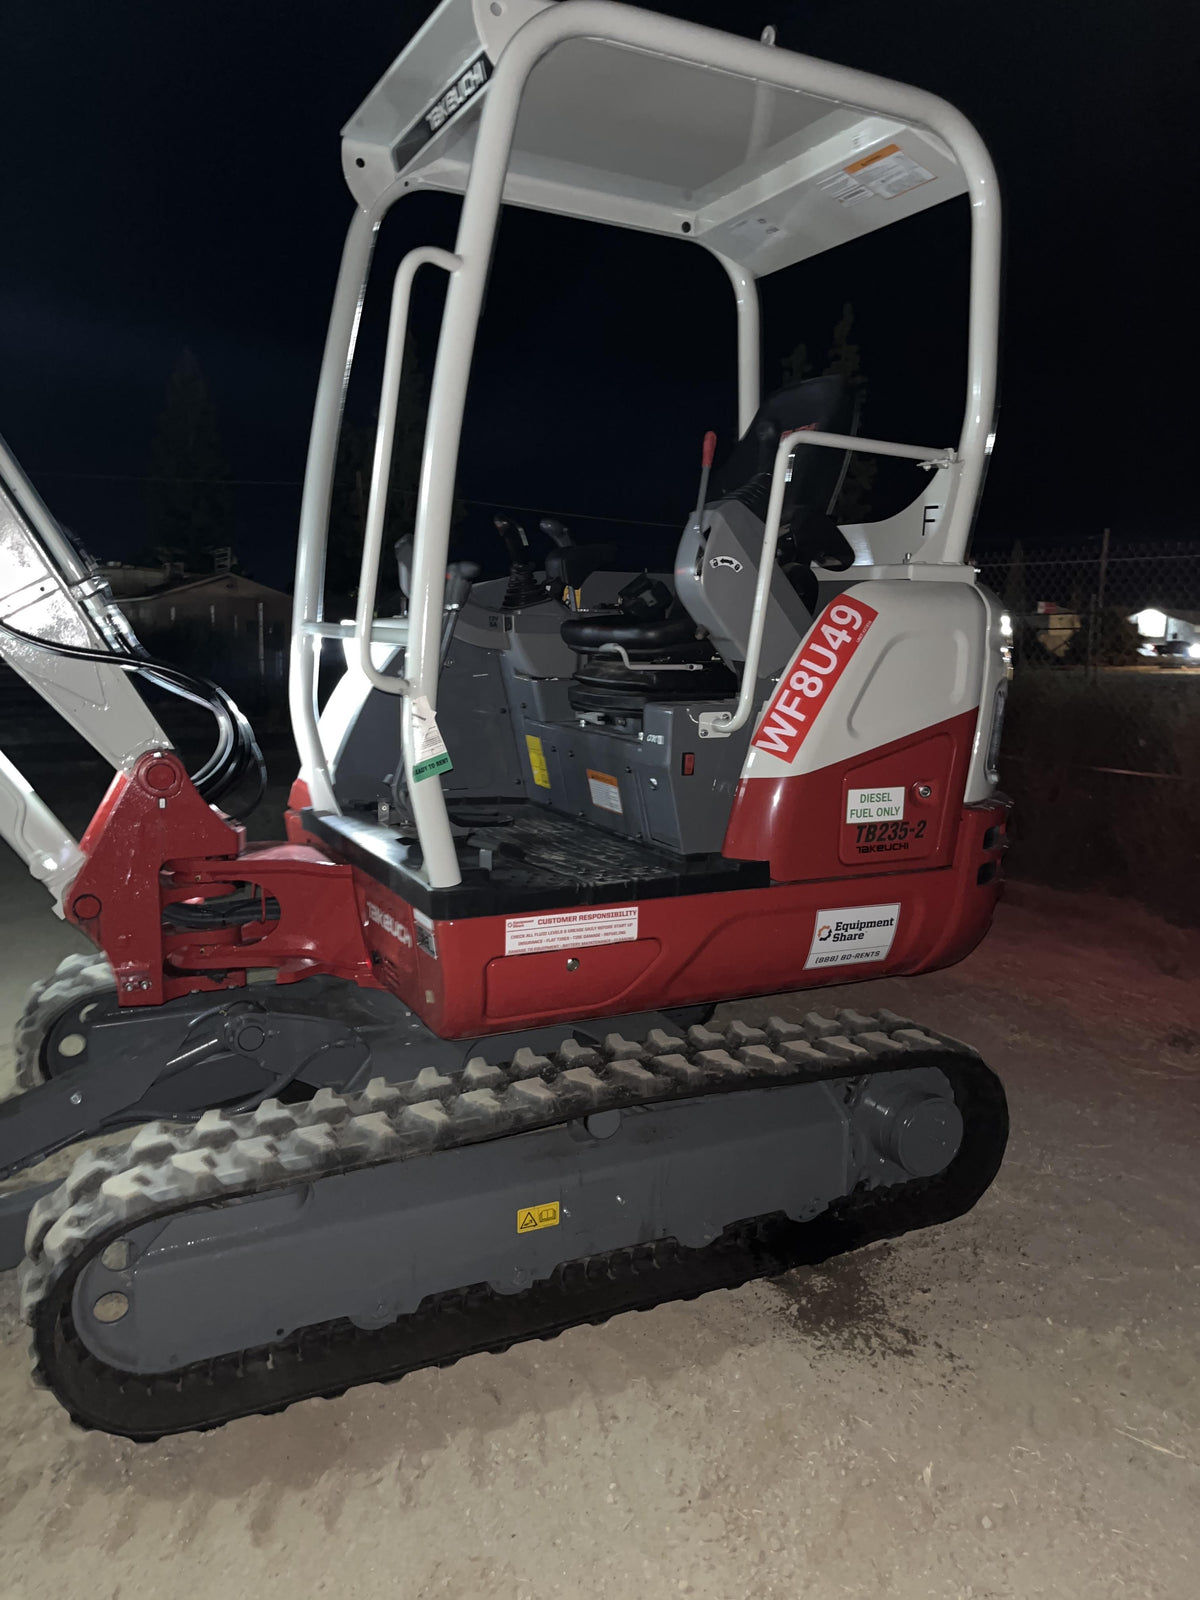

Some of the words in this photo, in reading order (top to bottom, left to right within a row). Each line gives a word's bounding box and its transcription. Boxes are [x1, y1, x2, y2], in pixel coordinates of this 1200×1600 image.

[922, 505, 939, 536] F
[755, 604, 863, 753] WF8U49
[860, 792, 893, 804] DIESEL
[850, 808, 874, 819] FUEL
[876, 806, 901, 817] ONLY
[856, 820, 927, 843] TB235-2
[537, 915, 578, 926] CUSTOMER
[579, 910, 637, 921] RESPONSIBILITY
[834, 917, 895, 933] Equipment
[832, 932, 865, 942] Share
[815, 955, 839, 964] (888)
